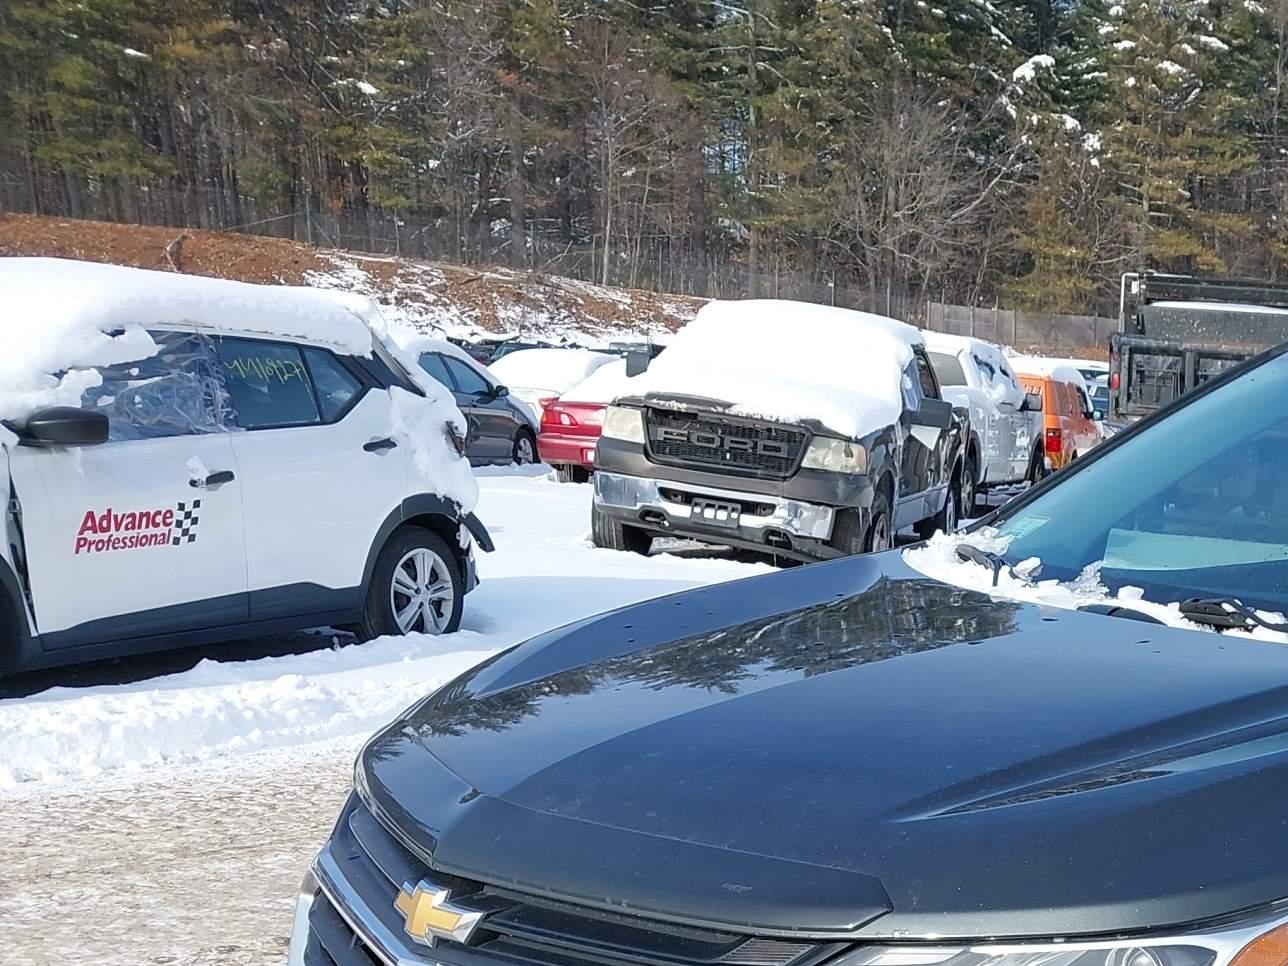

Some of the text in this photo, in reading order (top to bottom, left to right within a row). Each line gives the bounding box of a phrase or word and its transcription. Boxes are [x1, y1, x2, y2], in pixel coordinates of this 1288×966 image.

[657, 427, 789, 457] FORD
[78, 508, 174, 536] Advance
[74, 528, 172, 555] Professional
